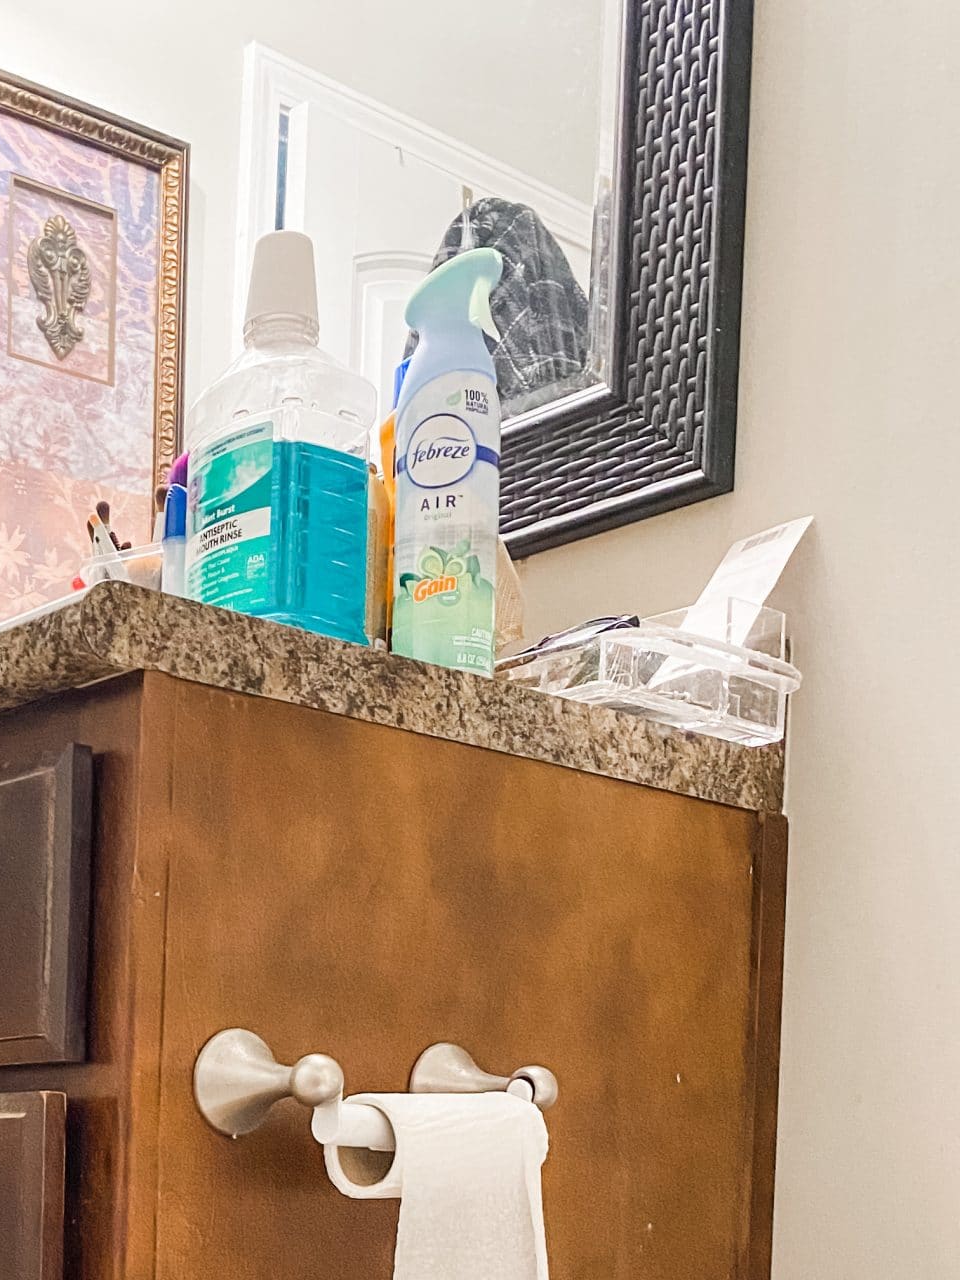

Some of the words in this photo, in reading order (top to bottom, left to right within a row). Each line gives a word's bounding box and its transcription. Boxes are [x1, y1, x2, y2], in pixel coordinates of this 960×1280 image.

[465, 389, 488, 404] 100%
[412, 437, 470, 469] febreze
[217, 505, 235, 518] Burst
[200, 519, 238, 542] ANTISEPTIC
[197, 540, 219, 556] MOUTH
[220, 529, 242, 544] RINSE
[248, 554, 264, 562] ADA
[414, 576, 456, 603] Gain
